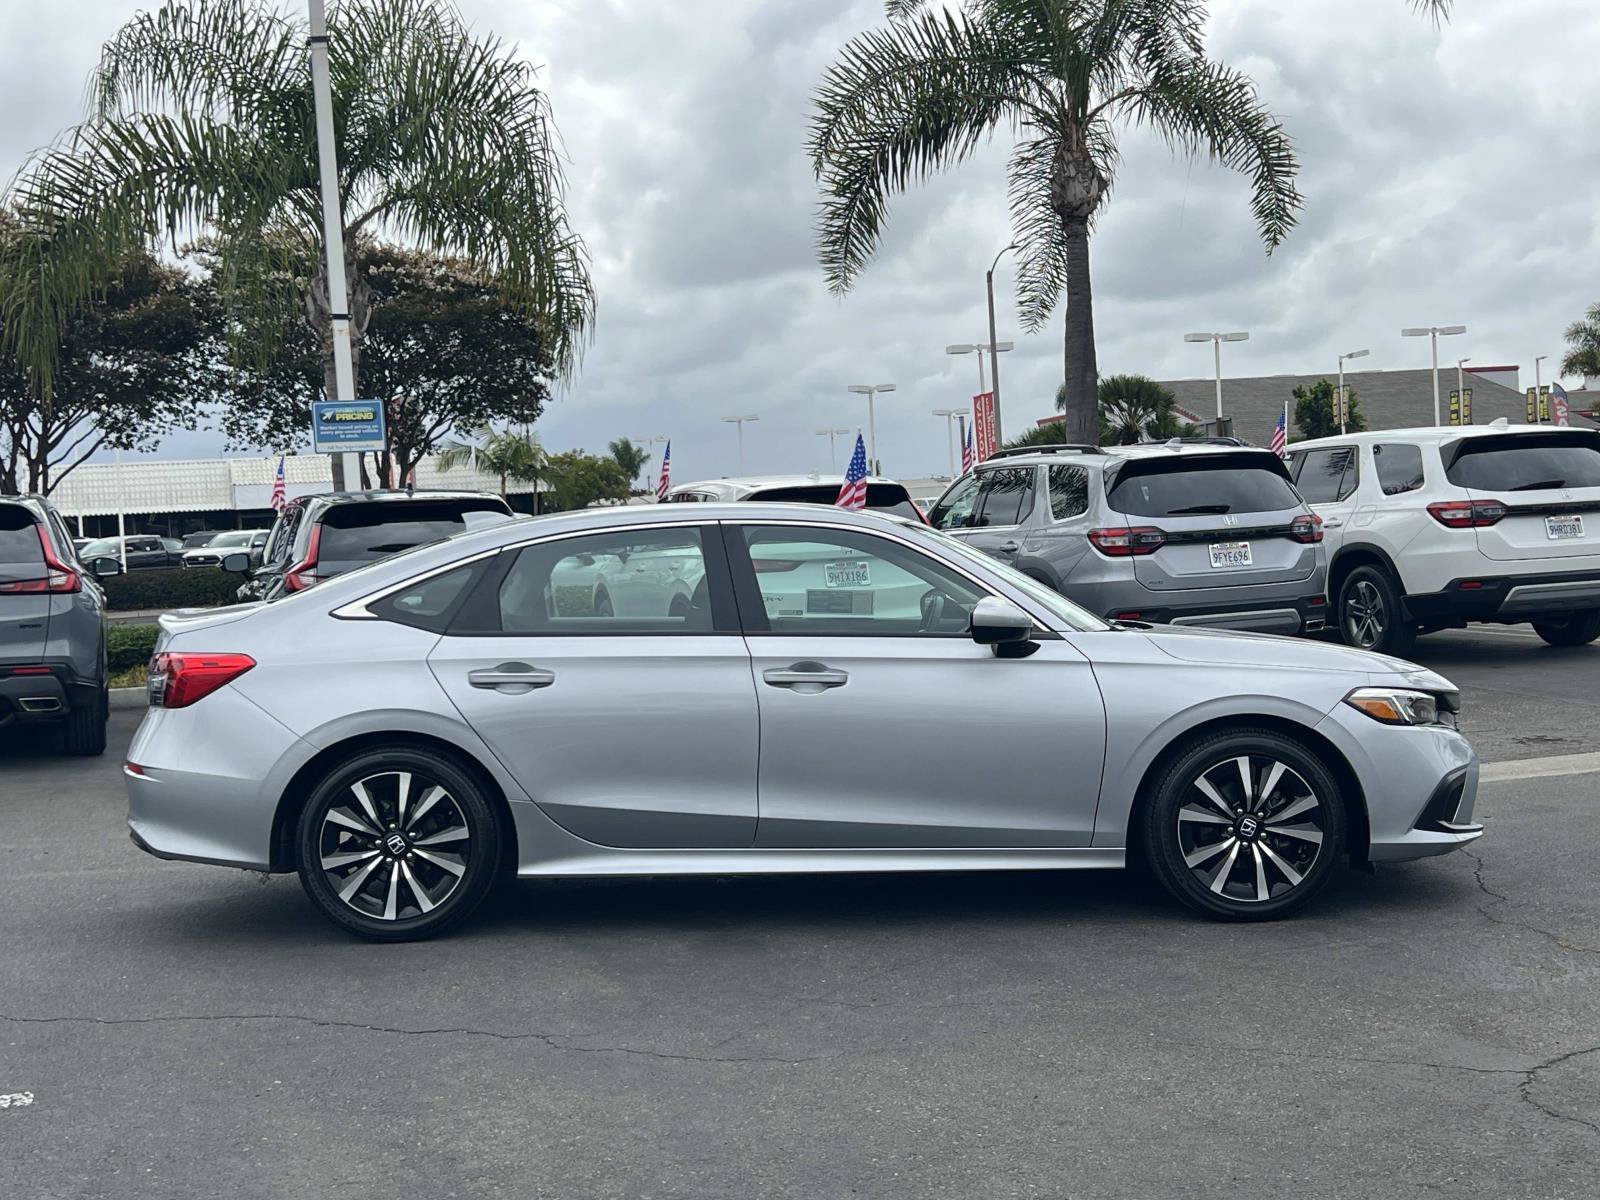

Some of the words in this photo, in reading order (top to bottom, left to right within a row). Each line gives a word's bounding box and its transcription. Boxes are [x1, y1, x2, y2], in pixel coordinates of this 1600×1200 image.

[336, 412, 374, 421] PRICING
[976, 400, 985, 460] TOYOTA
[1213, 550, 1249, 564] 9FYE696
[828, 570, 867, 583] 9HIX186
